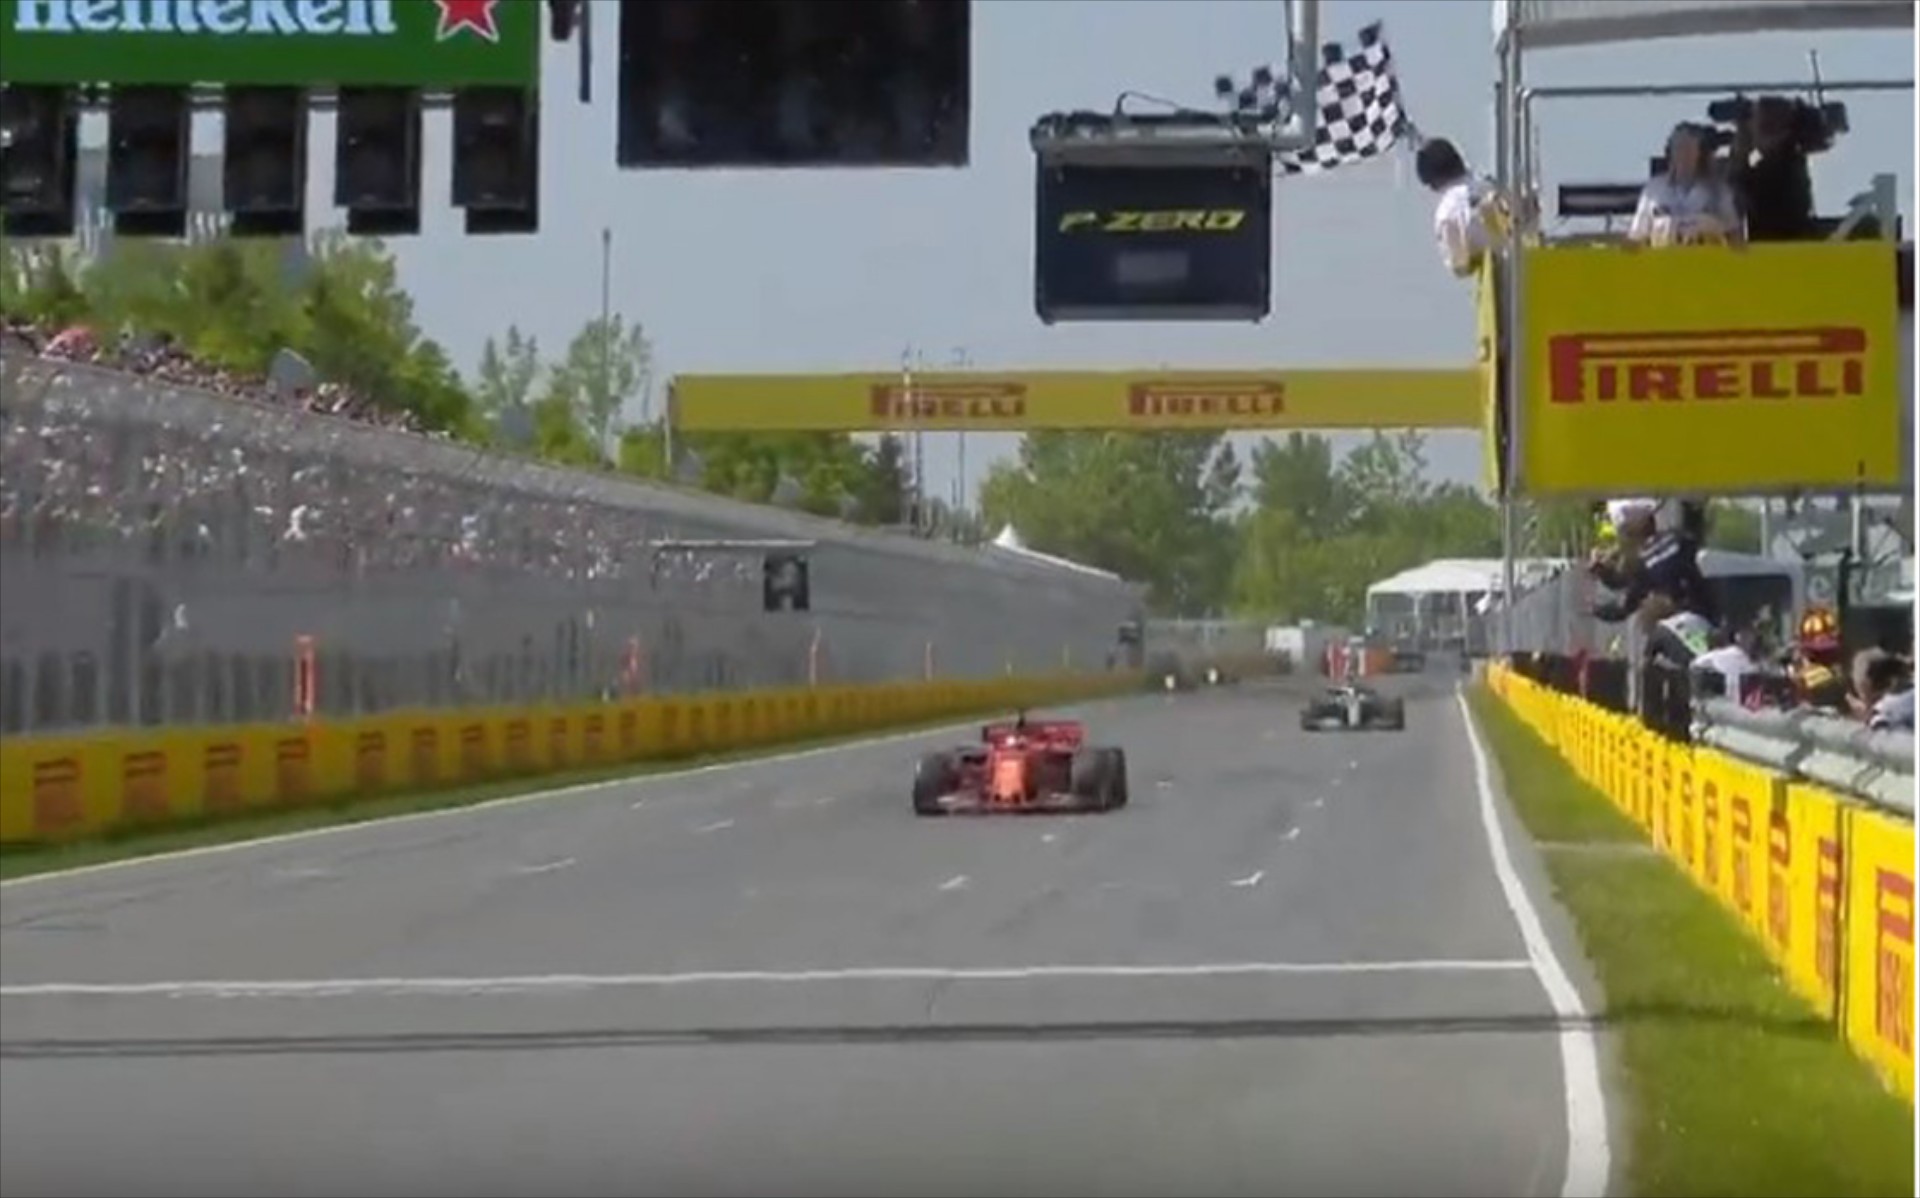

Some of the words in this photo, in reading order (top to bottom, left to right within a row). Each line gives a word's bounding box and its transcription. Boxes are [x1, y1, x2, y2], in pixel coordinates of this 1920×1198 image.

[1549, 327, 1866, 403] PIRELLI
[870, 383, 1026, 417] PIRELLI
[1129, 381, 1284, 416] PIRELLI
